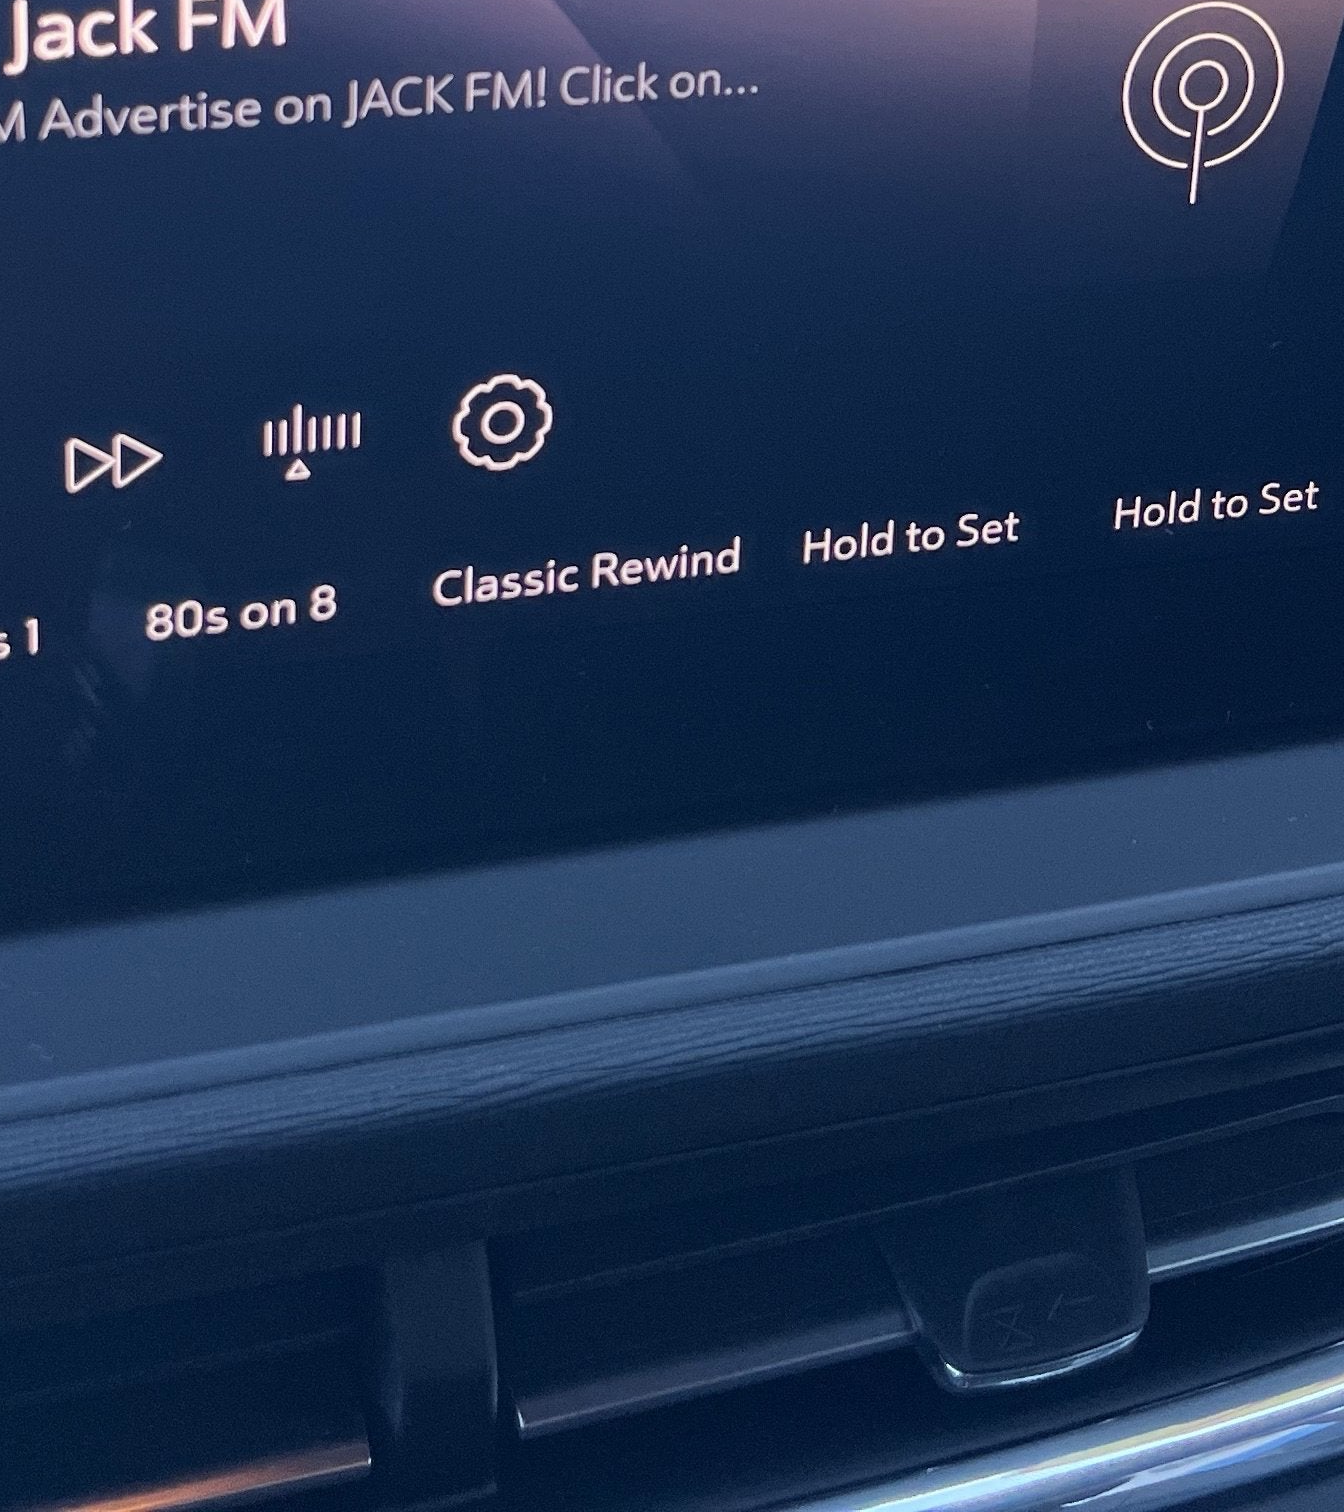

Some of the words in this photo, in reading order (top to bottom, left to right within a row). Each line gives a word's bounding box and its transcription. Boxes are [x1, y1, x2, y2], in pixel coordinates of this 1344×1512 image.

[37, 90, 263, 142] Advertise
[273, 92, 333, 126] on
[341, 72, 455, 129] JACK
[464, 65, 548, 113] FM!
[558, 60, 659, 107] Click
[668, 69, 760, 100] on...
[1112, 487, 1202, 531] Hold
[1210, 490, 1249, 521] to
[1258, 480, 1320, 515] Set
[802, 518, 896, 566] Hold
[904, 521, 946, 553] to
[955, 511, 1021, 548] Set
[430, 558, 580, 607] Classic
[589, 535, 742, 591] Rewind
[22, 615, 40, 657] 1
[144, 597, 231, 642] 80s
[237, 598, 297, 631] on
[306, 583, 340, 623] 8
